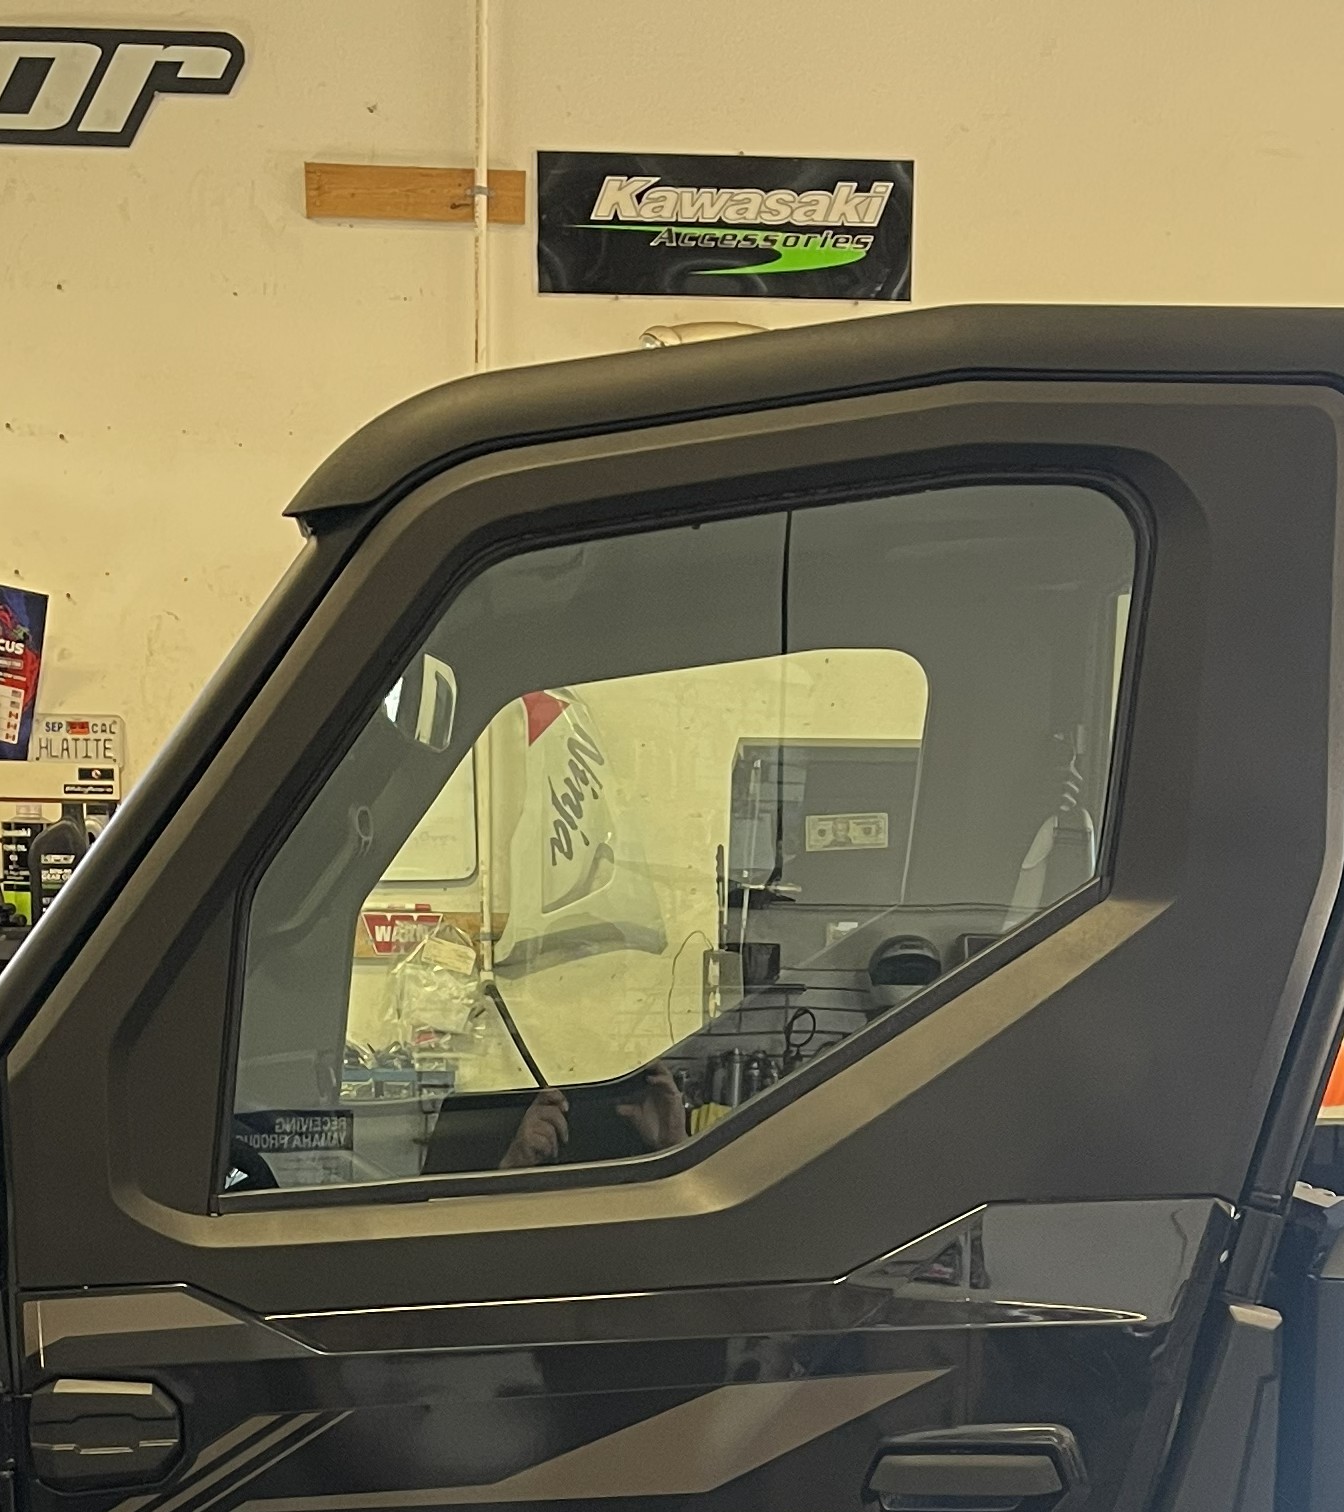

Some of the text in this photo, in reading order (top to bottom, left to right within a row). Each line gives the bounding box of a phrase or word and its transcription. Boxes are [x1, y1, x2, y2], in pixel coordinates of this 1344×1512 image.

[590, 175, 895, 227] Kawasaki
[650, 226, 874, 251] Accessories
[44, 721, 117, 735] SEP CAL
[547, 723, 606, 867] Ninja
